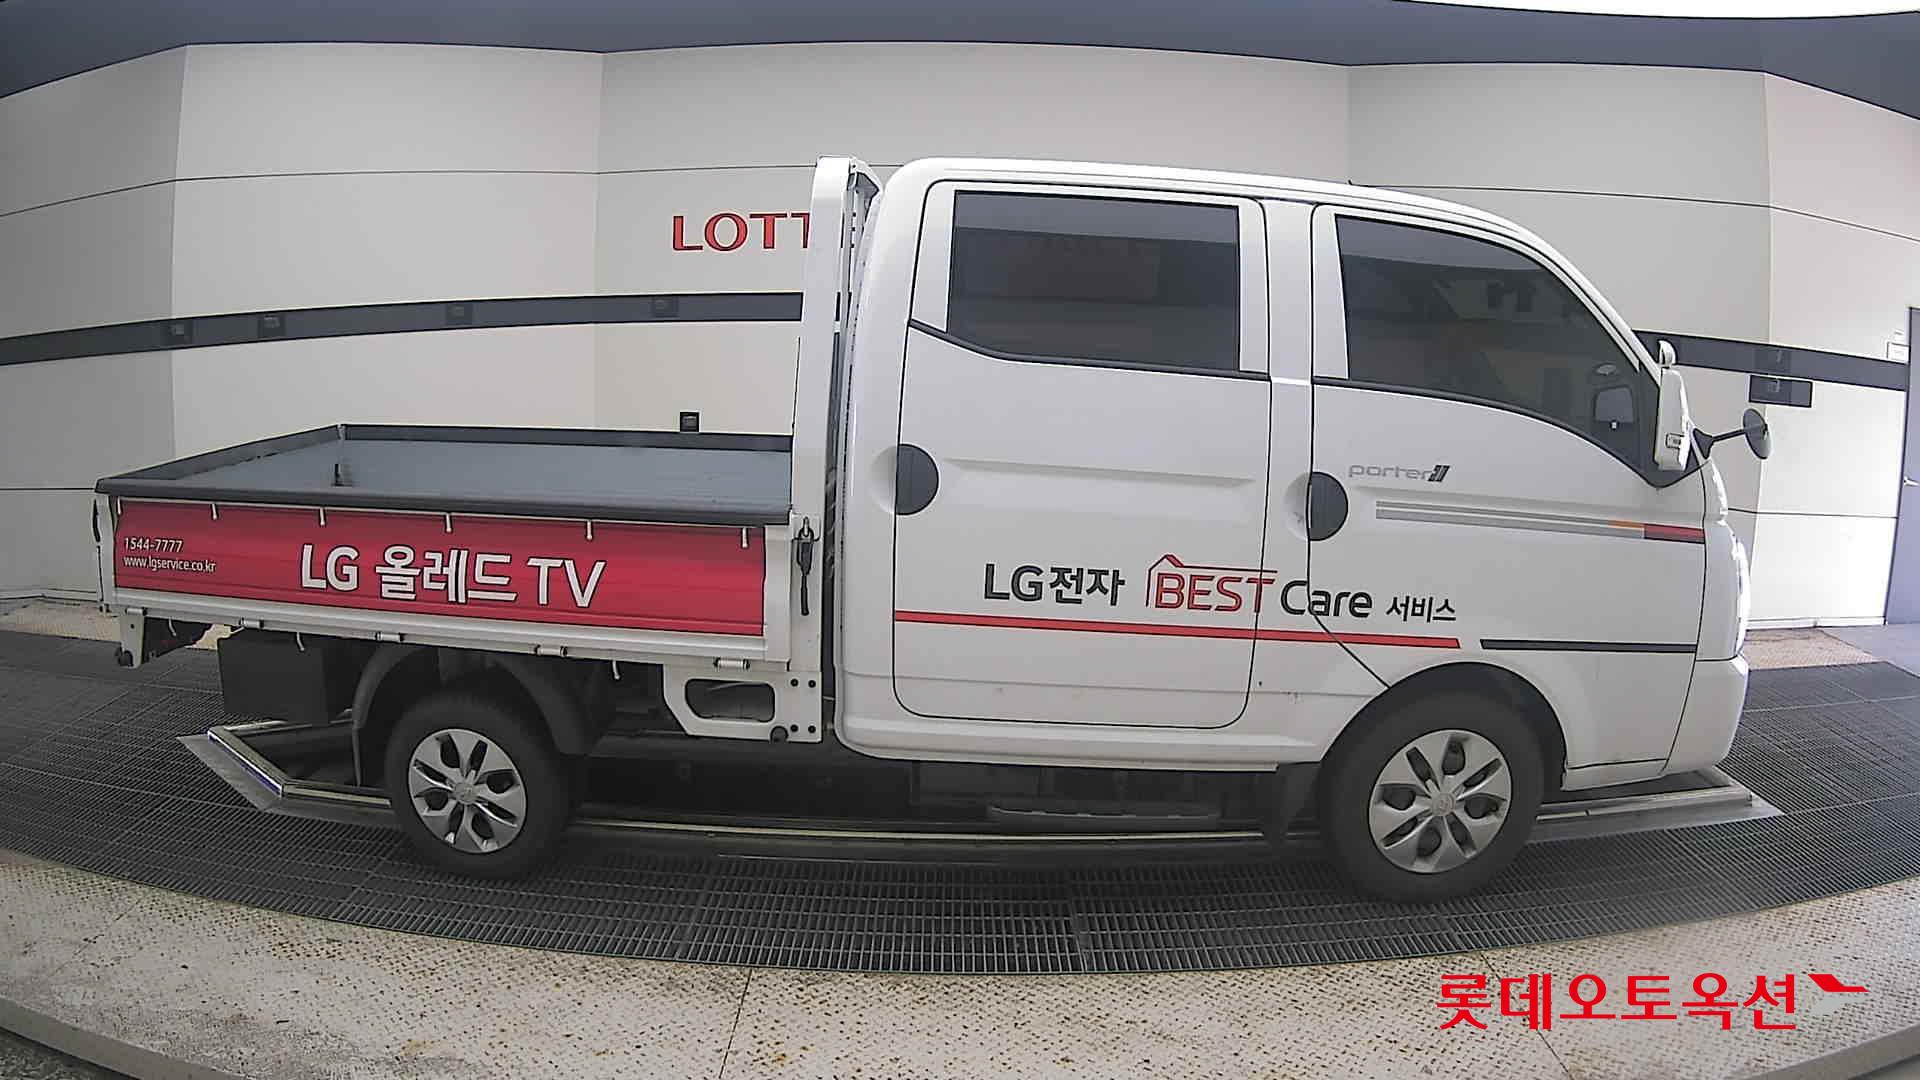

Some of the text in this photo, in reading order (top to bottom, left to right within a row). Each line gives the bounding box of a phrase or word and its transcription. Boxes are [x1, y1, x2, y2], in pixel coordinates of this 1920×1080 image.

[123, 556, 216, 573] www.lgservice.co.kr
[124, 537, 183, 553] 1544-7777
[301, 544, 606, 608] LG 올레드 TV
[984, 563, 1457, 624] LG전자 BEST Care 서비스
